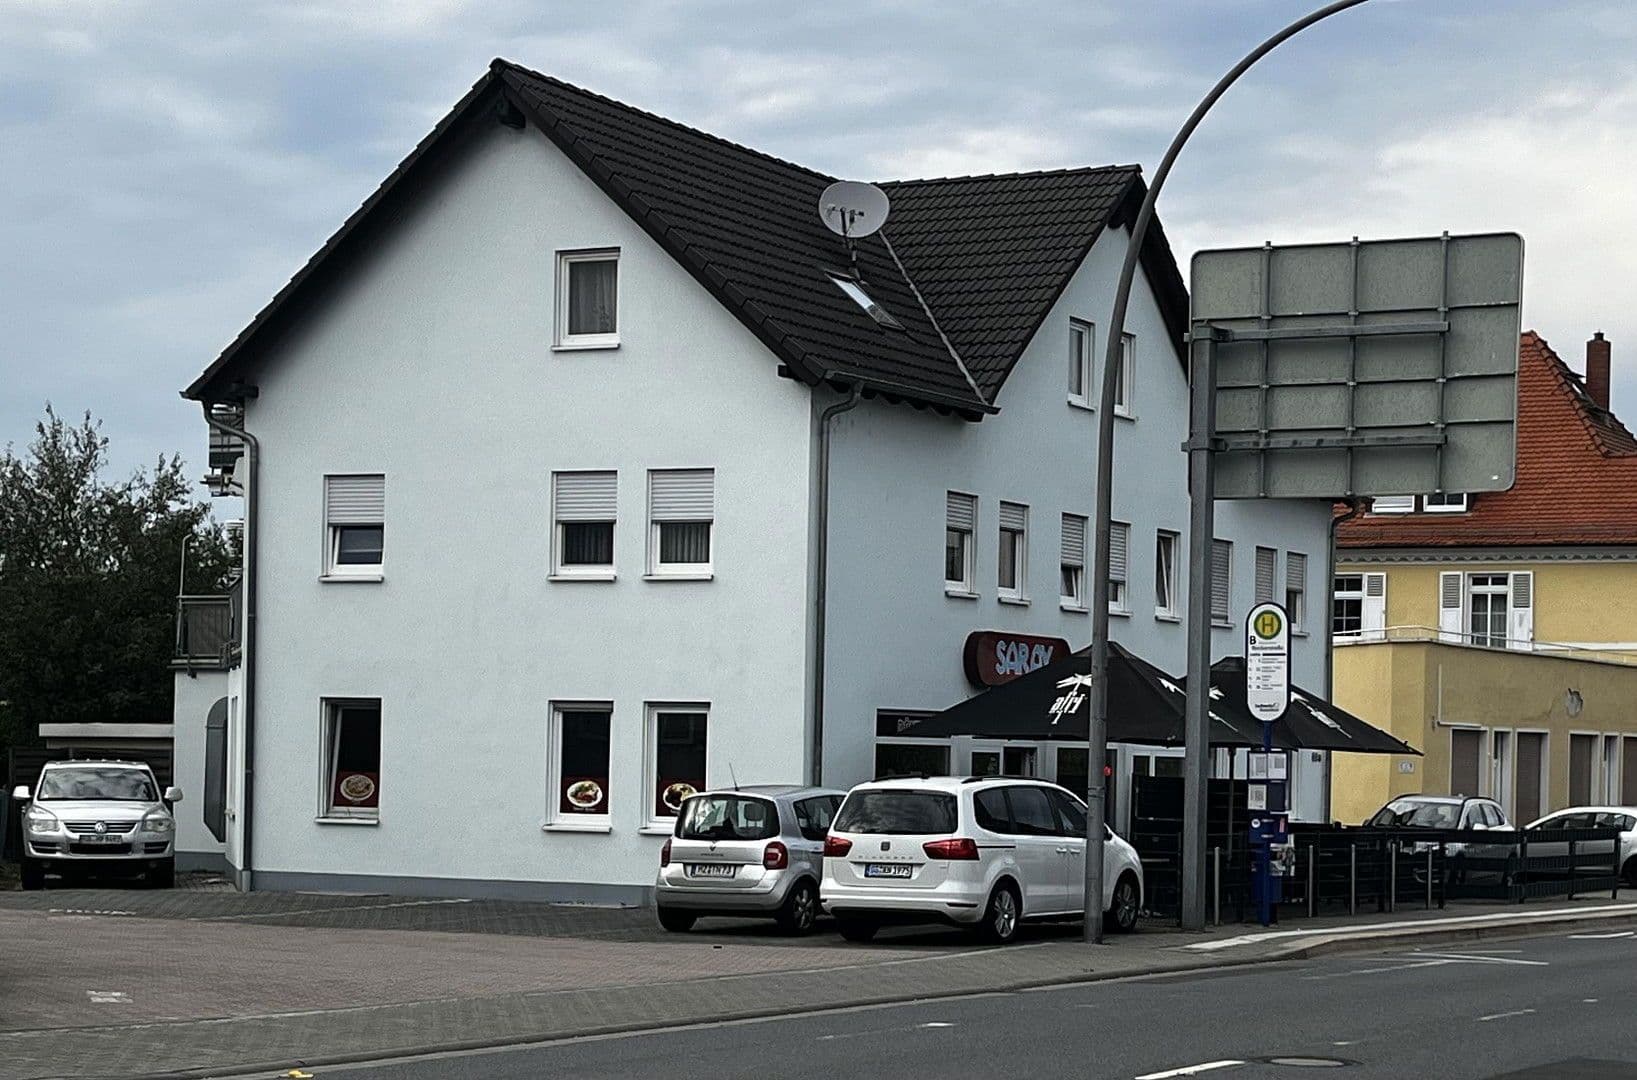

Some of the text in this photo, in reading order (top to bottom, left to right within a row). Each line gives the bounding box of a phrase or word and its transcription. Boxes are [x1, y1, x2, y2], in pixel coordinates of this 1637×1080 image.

[1262, 615, 1274, 633] H
[1250, 636, 1257, 645] B
[995, 640, 1054, 675] SARAY
